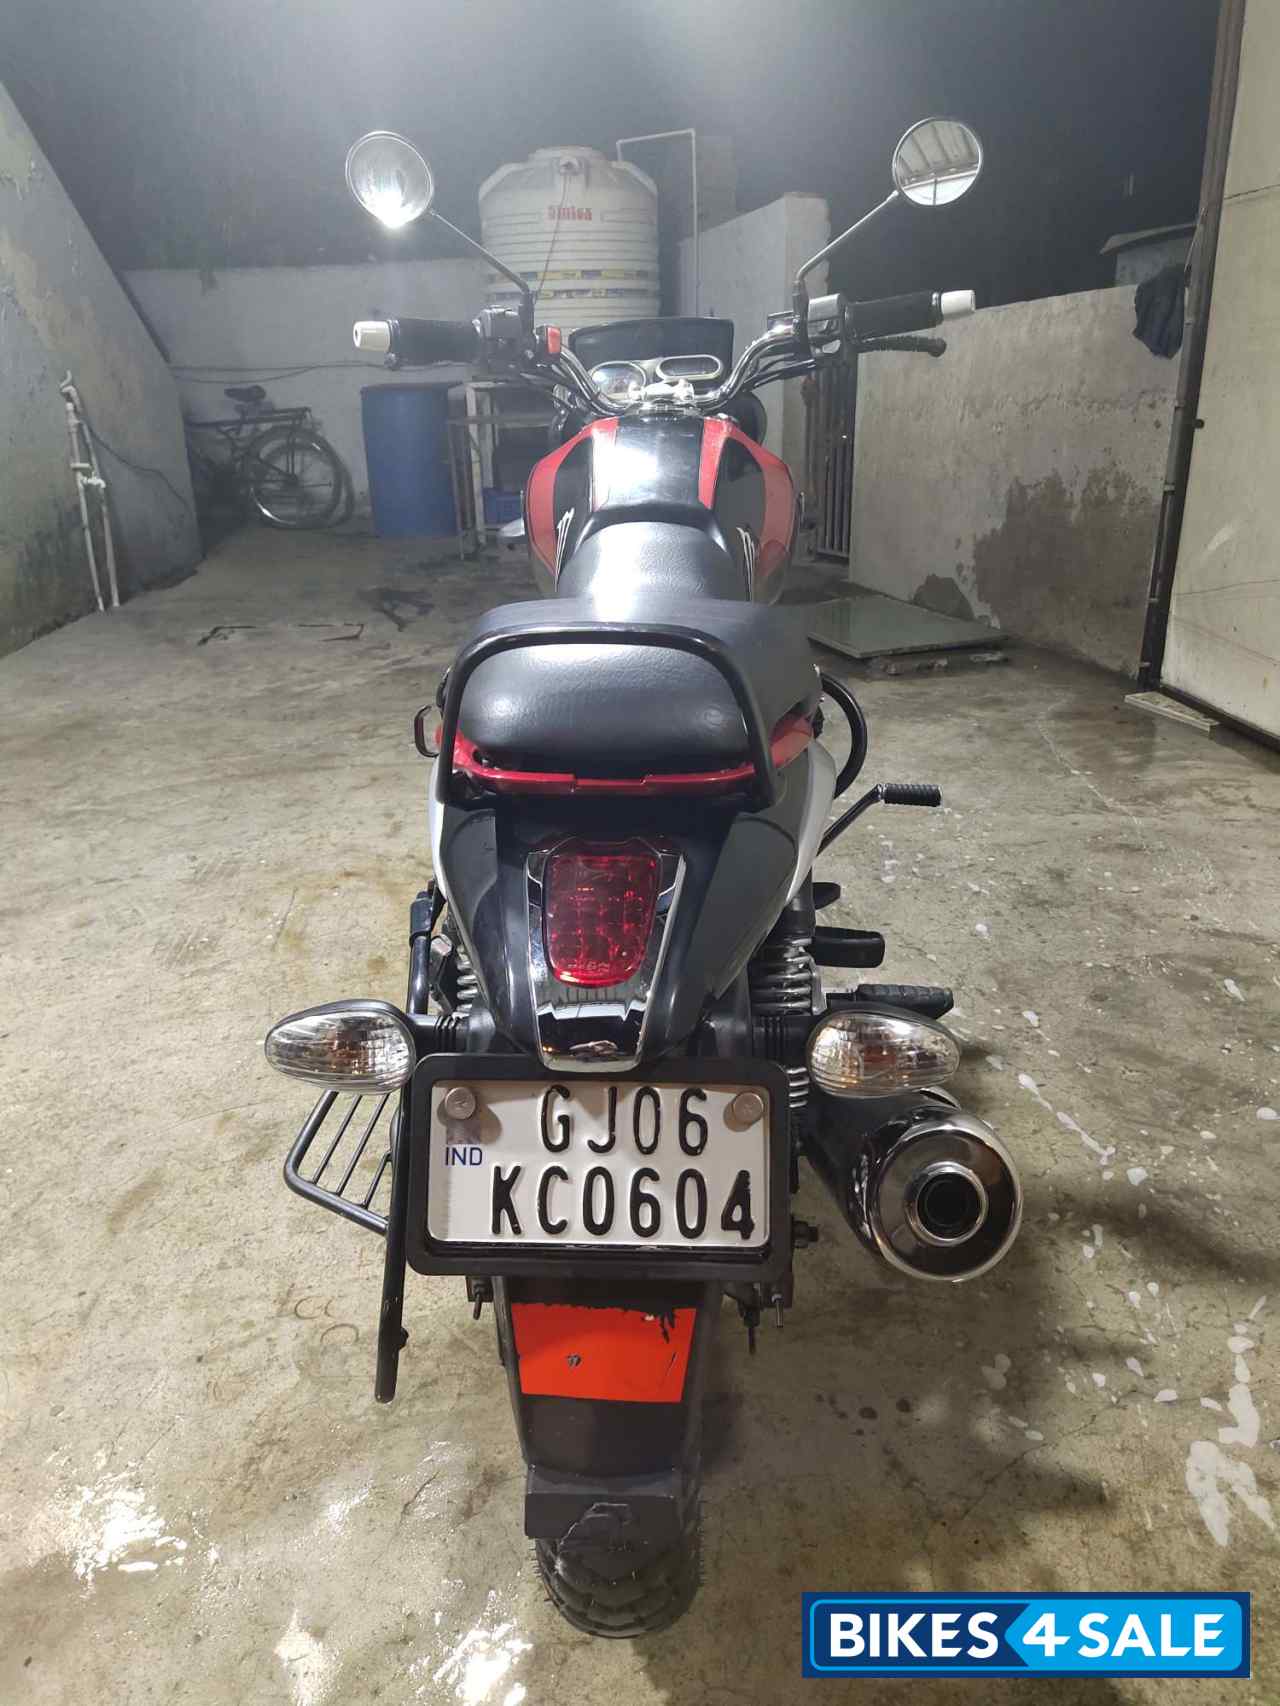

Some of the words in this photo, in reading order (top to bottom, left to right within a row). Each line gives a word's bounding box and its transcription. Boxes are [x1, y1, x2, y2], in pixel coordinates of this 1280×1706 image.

[445, 1147, 483, 1166] IND
[540, 1084, 709, 1157] GJ06
[491, 1164, 755, 1240] KC0604
